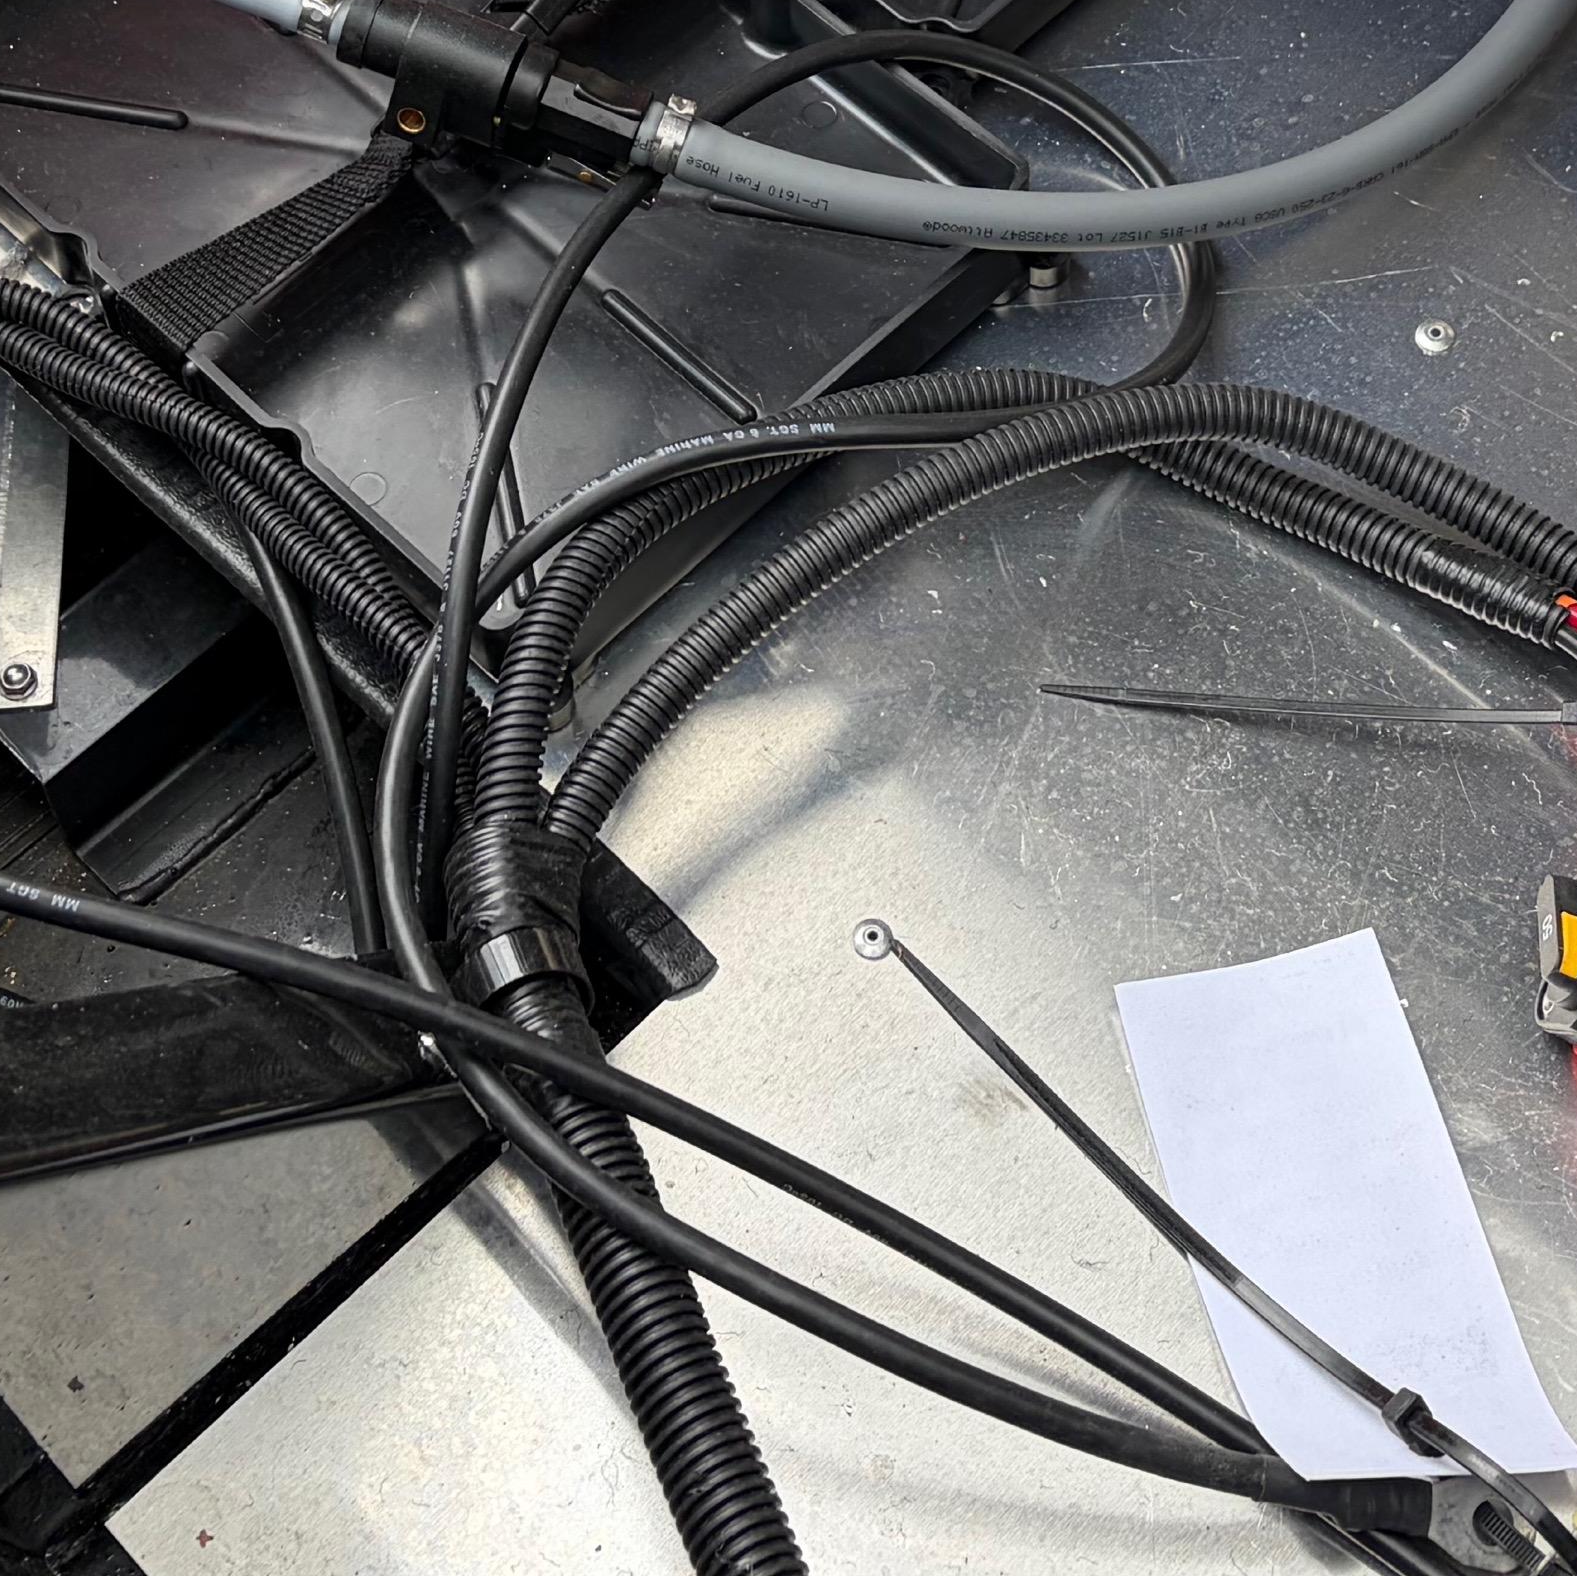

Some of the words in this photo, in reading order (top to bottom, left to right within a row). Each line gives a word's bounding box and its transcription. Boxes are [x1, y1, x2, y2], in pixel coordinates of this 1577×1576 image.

[686, 155, 720, 176] Hose
[728, 171, 761, 194] Fuel
[769, 185, 829, 211] LP-1610
[1216, 214, 1246, 230] Type
[1000, 229, 1069, 242] 33435847
[1078, 231, 1103, 242] Lot
[1111, 229, 1152, 242] J1527
[722, 431, 746, 442] GA
[809, 421, 836, 434] MM
[655, 435, 714, 457] MARINE
[609, 455, 648, 477] WIRE
[430, 673, 439, 707] SAE
[426, 717, 435, 760] WIRE
[5, 883, 39, 902] SGT
[50, 894, 81, 914] MM
[1542, 913, 1554, 941] 50
